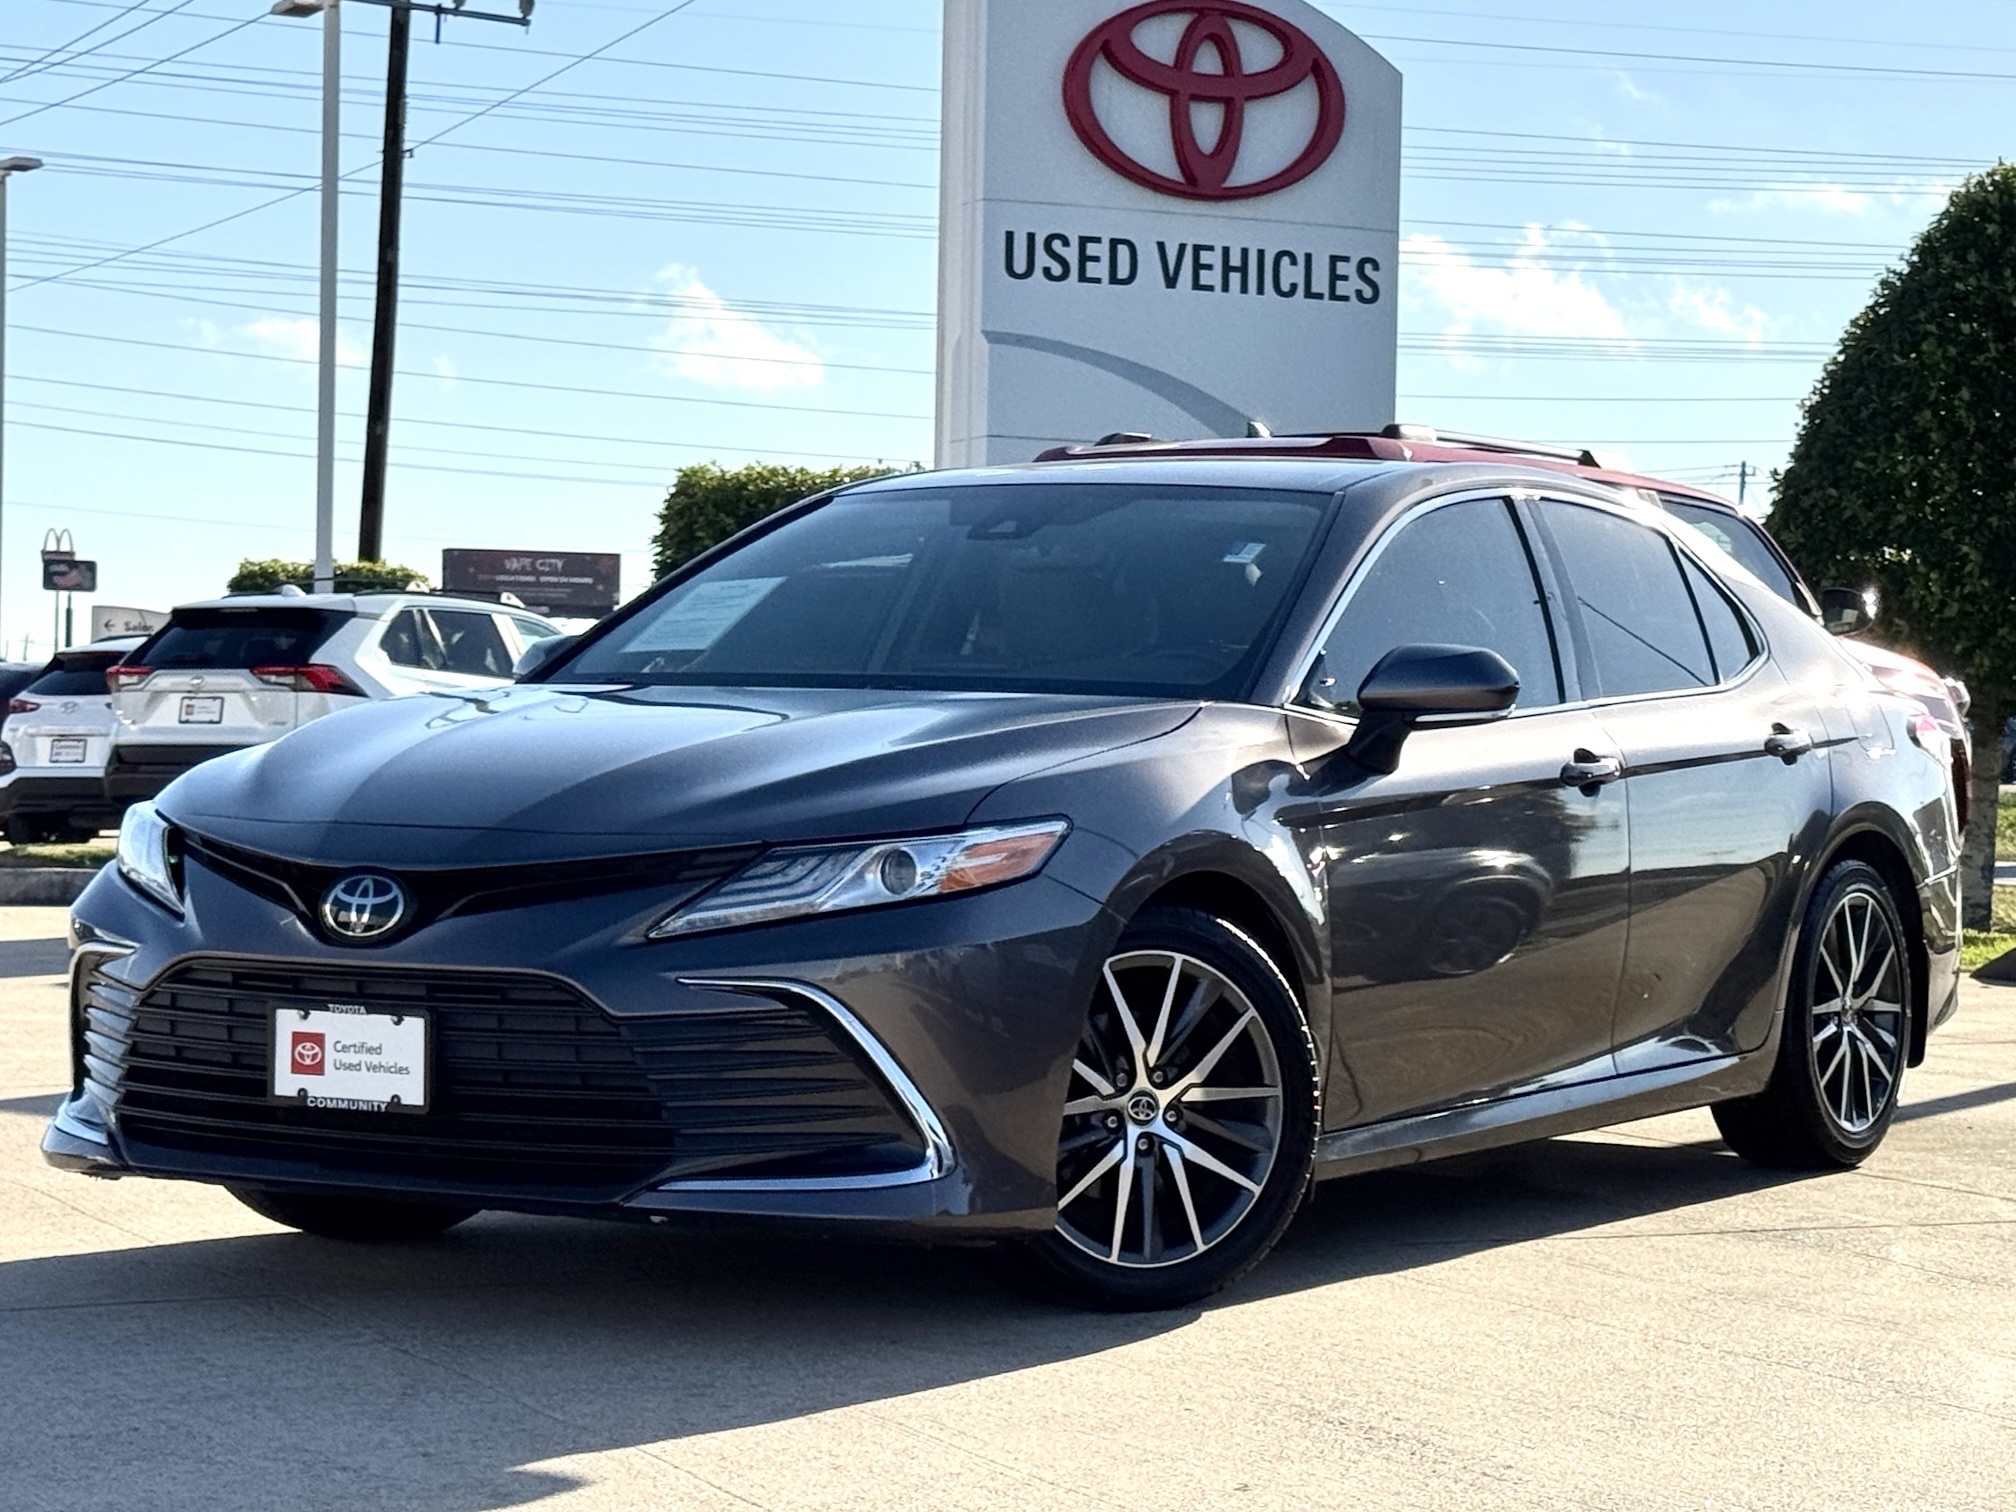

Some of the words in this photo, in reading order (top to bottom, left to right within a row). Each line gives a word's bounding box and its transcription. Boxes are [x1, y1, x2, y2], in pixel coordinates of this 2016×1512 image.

[1004, 230, 1138, 286] USED
[1156, 241, 1380, 305] VEHICLES
[535, 558, 566, 573] CITY
[327, 1003, 367, 1015] TOYOTA
[333, 1040, 383, 1056] Certified
[333, 1059, 362, 1072] Used
[365, 1061, 410, 1076] Vehicles
[307, 1096, 388, 1113] COMMUNITY
